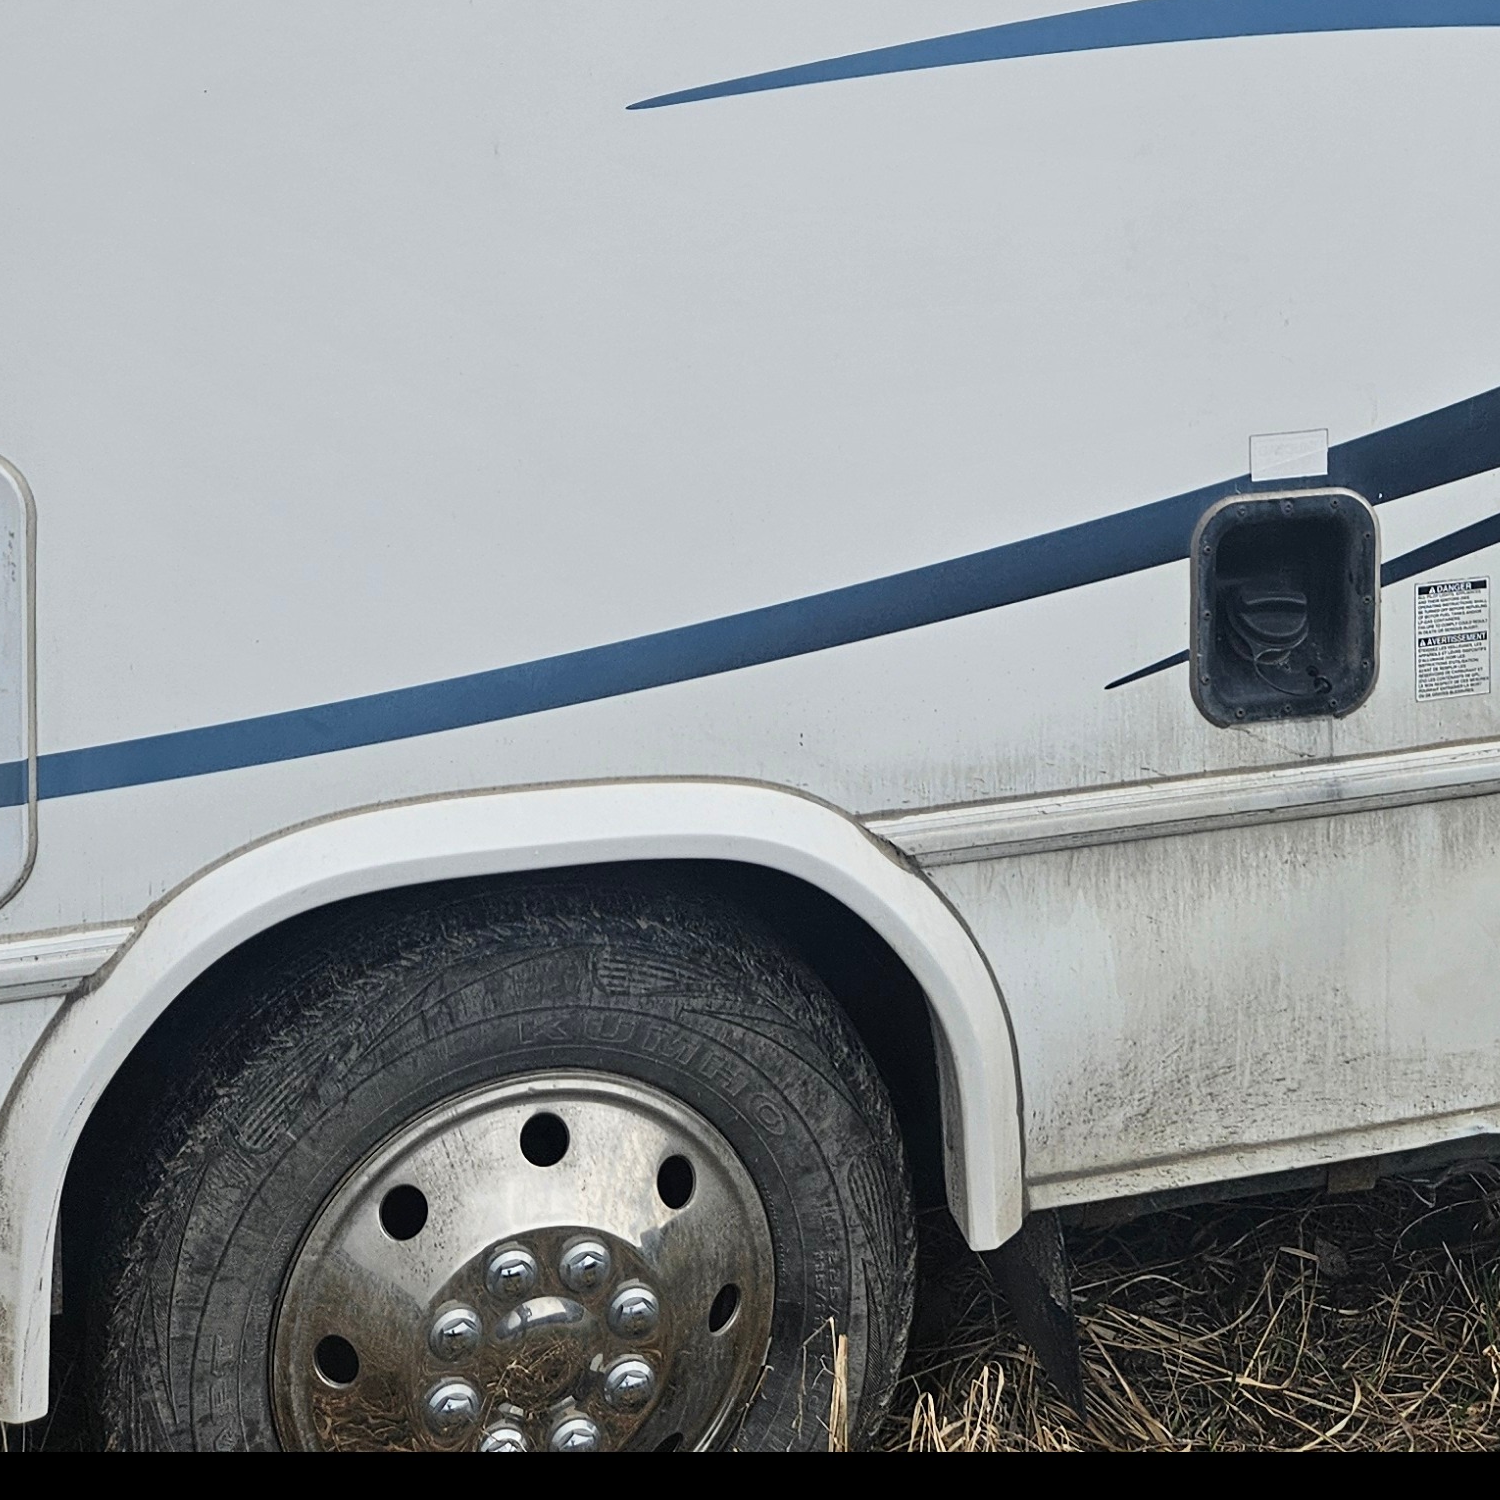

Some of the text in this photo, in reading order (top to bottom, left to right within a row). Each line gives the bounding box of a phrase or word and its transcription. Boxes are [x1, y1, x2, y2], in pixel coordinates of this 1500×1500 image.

[1437, 582, 1471, 593] DANGER
[1428, 632, 1485, 646] AVERTISSEMENT
[517, 1014, 788, 1136] KUMHO
